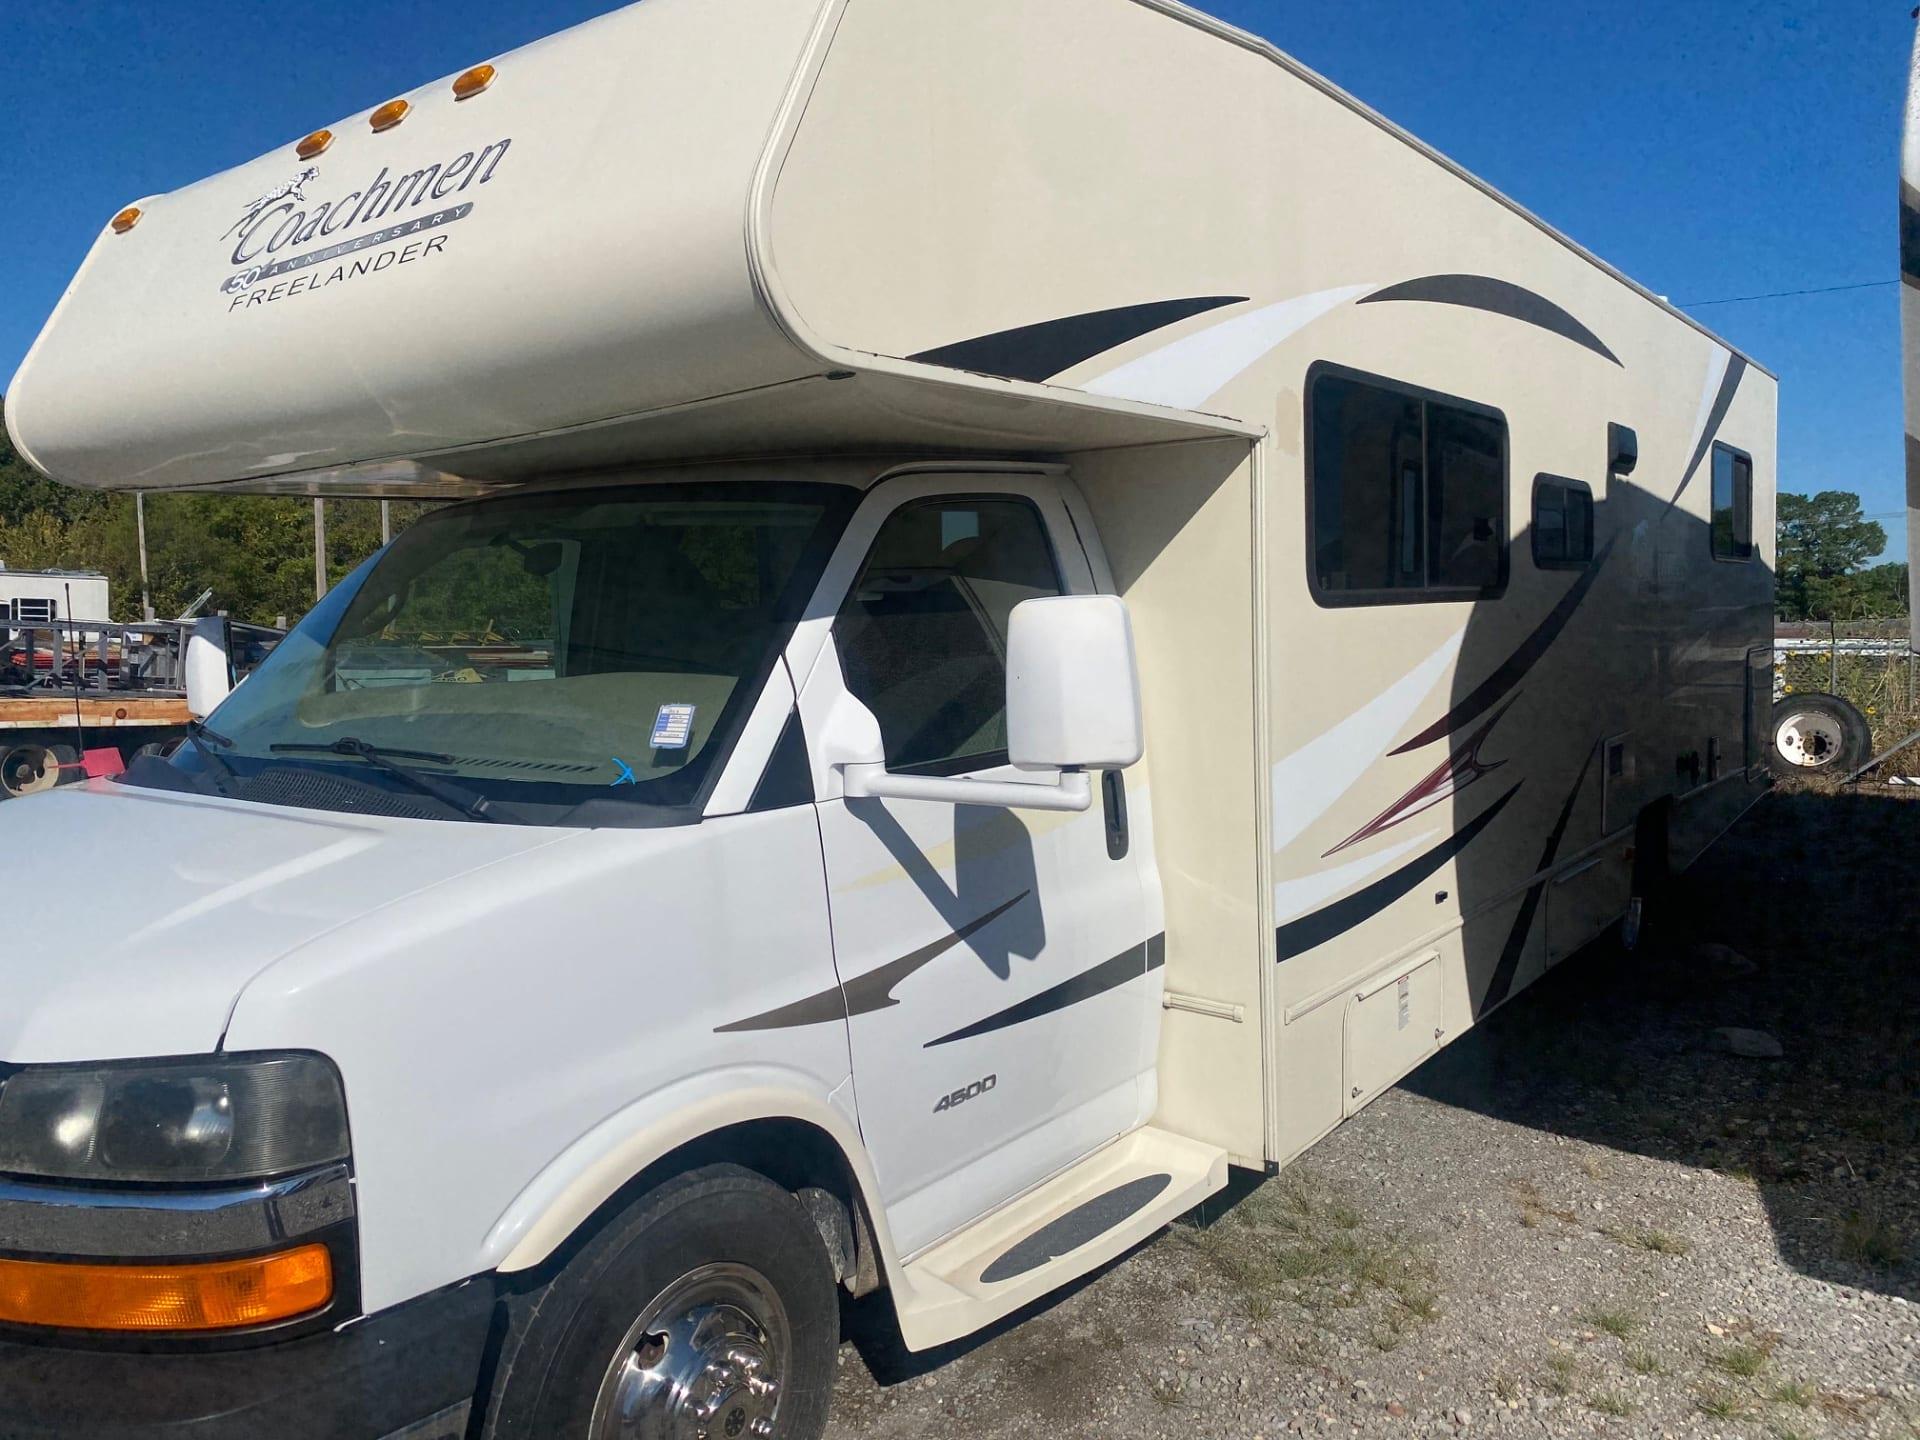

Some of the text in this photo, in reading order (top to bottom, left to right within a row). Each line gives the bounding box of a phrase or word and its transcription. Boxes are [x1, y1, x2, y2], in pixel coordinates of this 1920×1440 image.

[230, 138, 512, 266] Coachmen
[269, 206, 465, 276] ANNIVERSARY
[228, 234, 449, 313] FREELANDER
